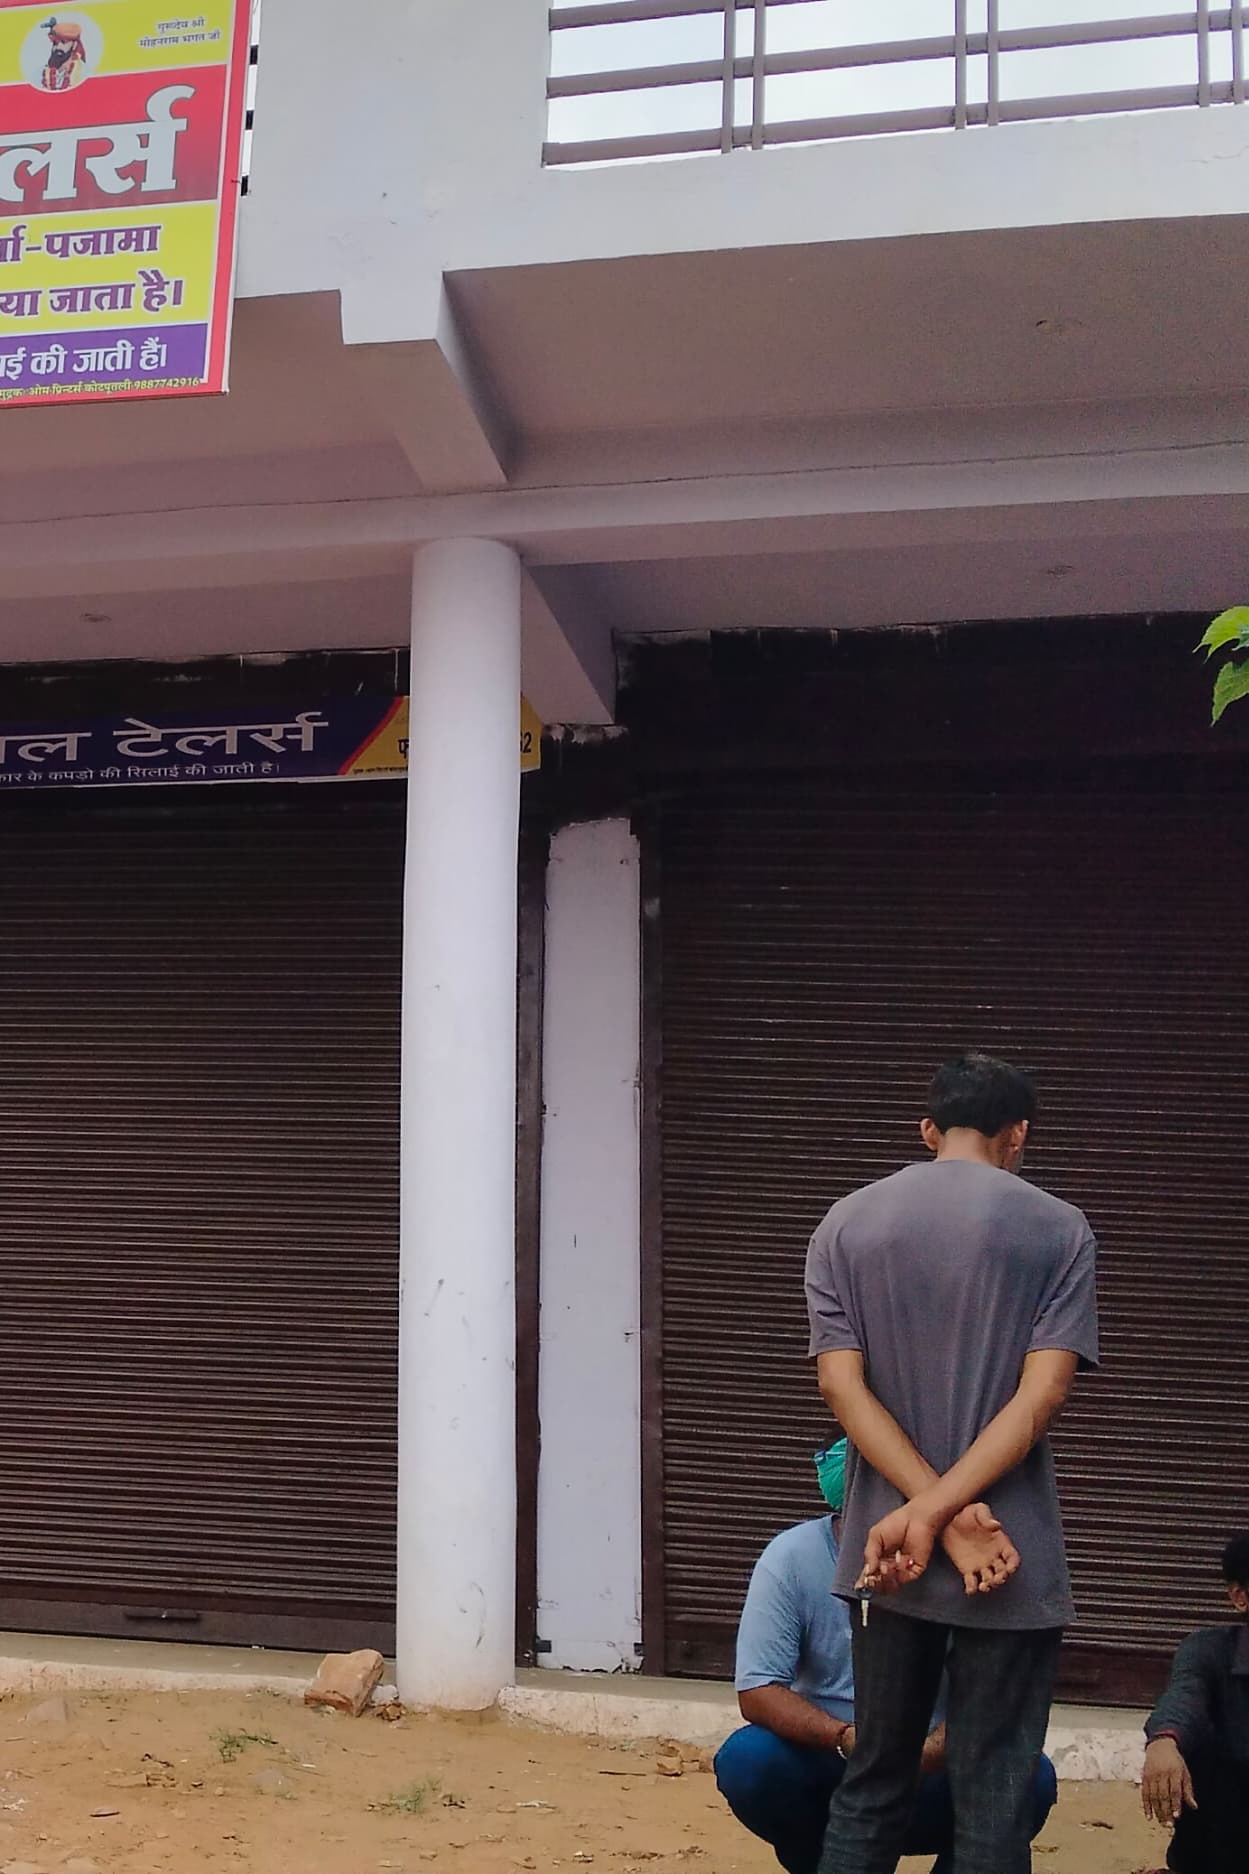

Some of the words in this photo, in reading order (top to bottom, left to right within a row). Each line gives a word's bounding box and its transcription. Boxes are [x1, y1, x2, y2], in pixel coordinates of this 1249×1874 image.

[49, 282, 136, 315] जाता
[29, 343, 68, 376] की
[73, 339, 135, 374] जाती
[134, 377, 200, 391] 9887742916
[113, 711, 329, 758] टेलर्स
[26, 768, 43, 782] के
[99, 766, 121, 779] की
[127, 764, 181, 779] सिलाई
[185, 763, 208, 777] की
[213, 761, 255, 775] जाती
